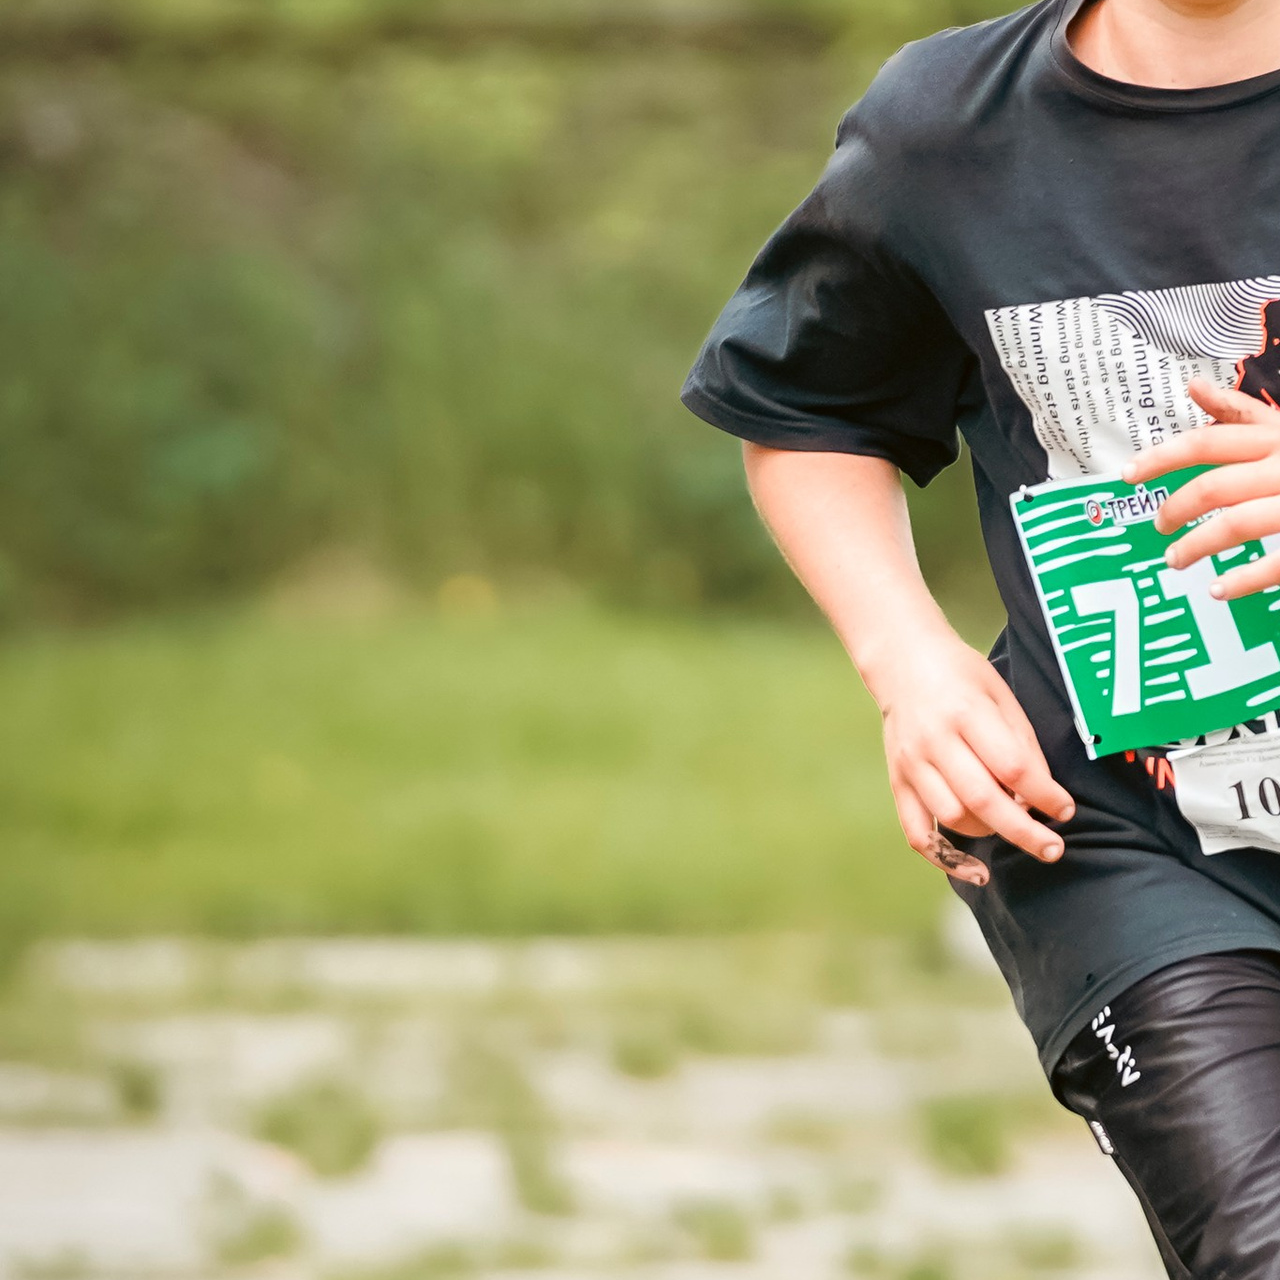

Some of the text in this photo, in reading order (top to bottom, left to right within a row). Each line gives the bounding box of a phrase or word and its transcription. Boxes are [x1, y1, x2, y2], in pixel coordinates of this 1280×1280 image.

[993, 309, 1013, 369] Winning
[1010, 306, 1028, 368] Winning
[1029, 305, 1050, 385] Winning
[1072, 300, 1100, 425] Winning starts within
[1055, 301, 1071, 364] Winning
[1064, 369, 1081, 411] starts
[1075, 415, 1093, 459] within
[1096, 350, 1110, 384] starts
[1104, 387, 1117, 423] within
[1115, 362, 1132, 404] starts
[1125, 408, 1143, 452] within
[1158, 356, 1177, 418] Winning
